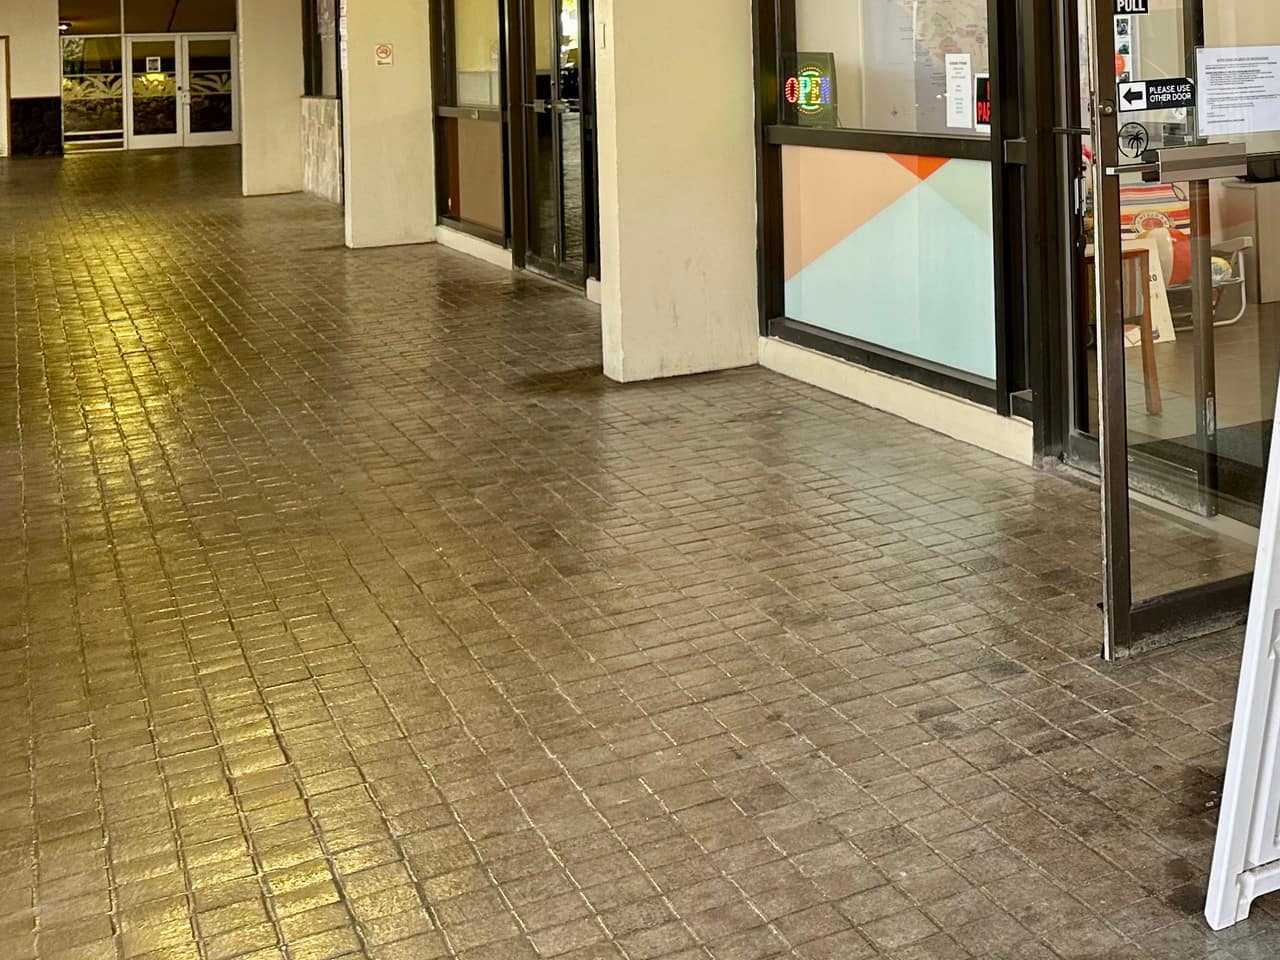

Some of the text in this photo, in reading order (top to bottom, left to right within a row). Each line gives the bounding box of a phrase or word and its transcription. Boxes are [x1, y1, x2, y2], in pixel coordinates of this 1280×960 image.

[784, 76, 830, 104] OPEN
[1150, 84, 1191, 94] PLEASE USE
[1150, 92, 1191, 102] OTHER DOOR
